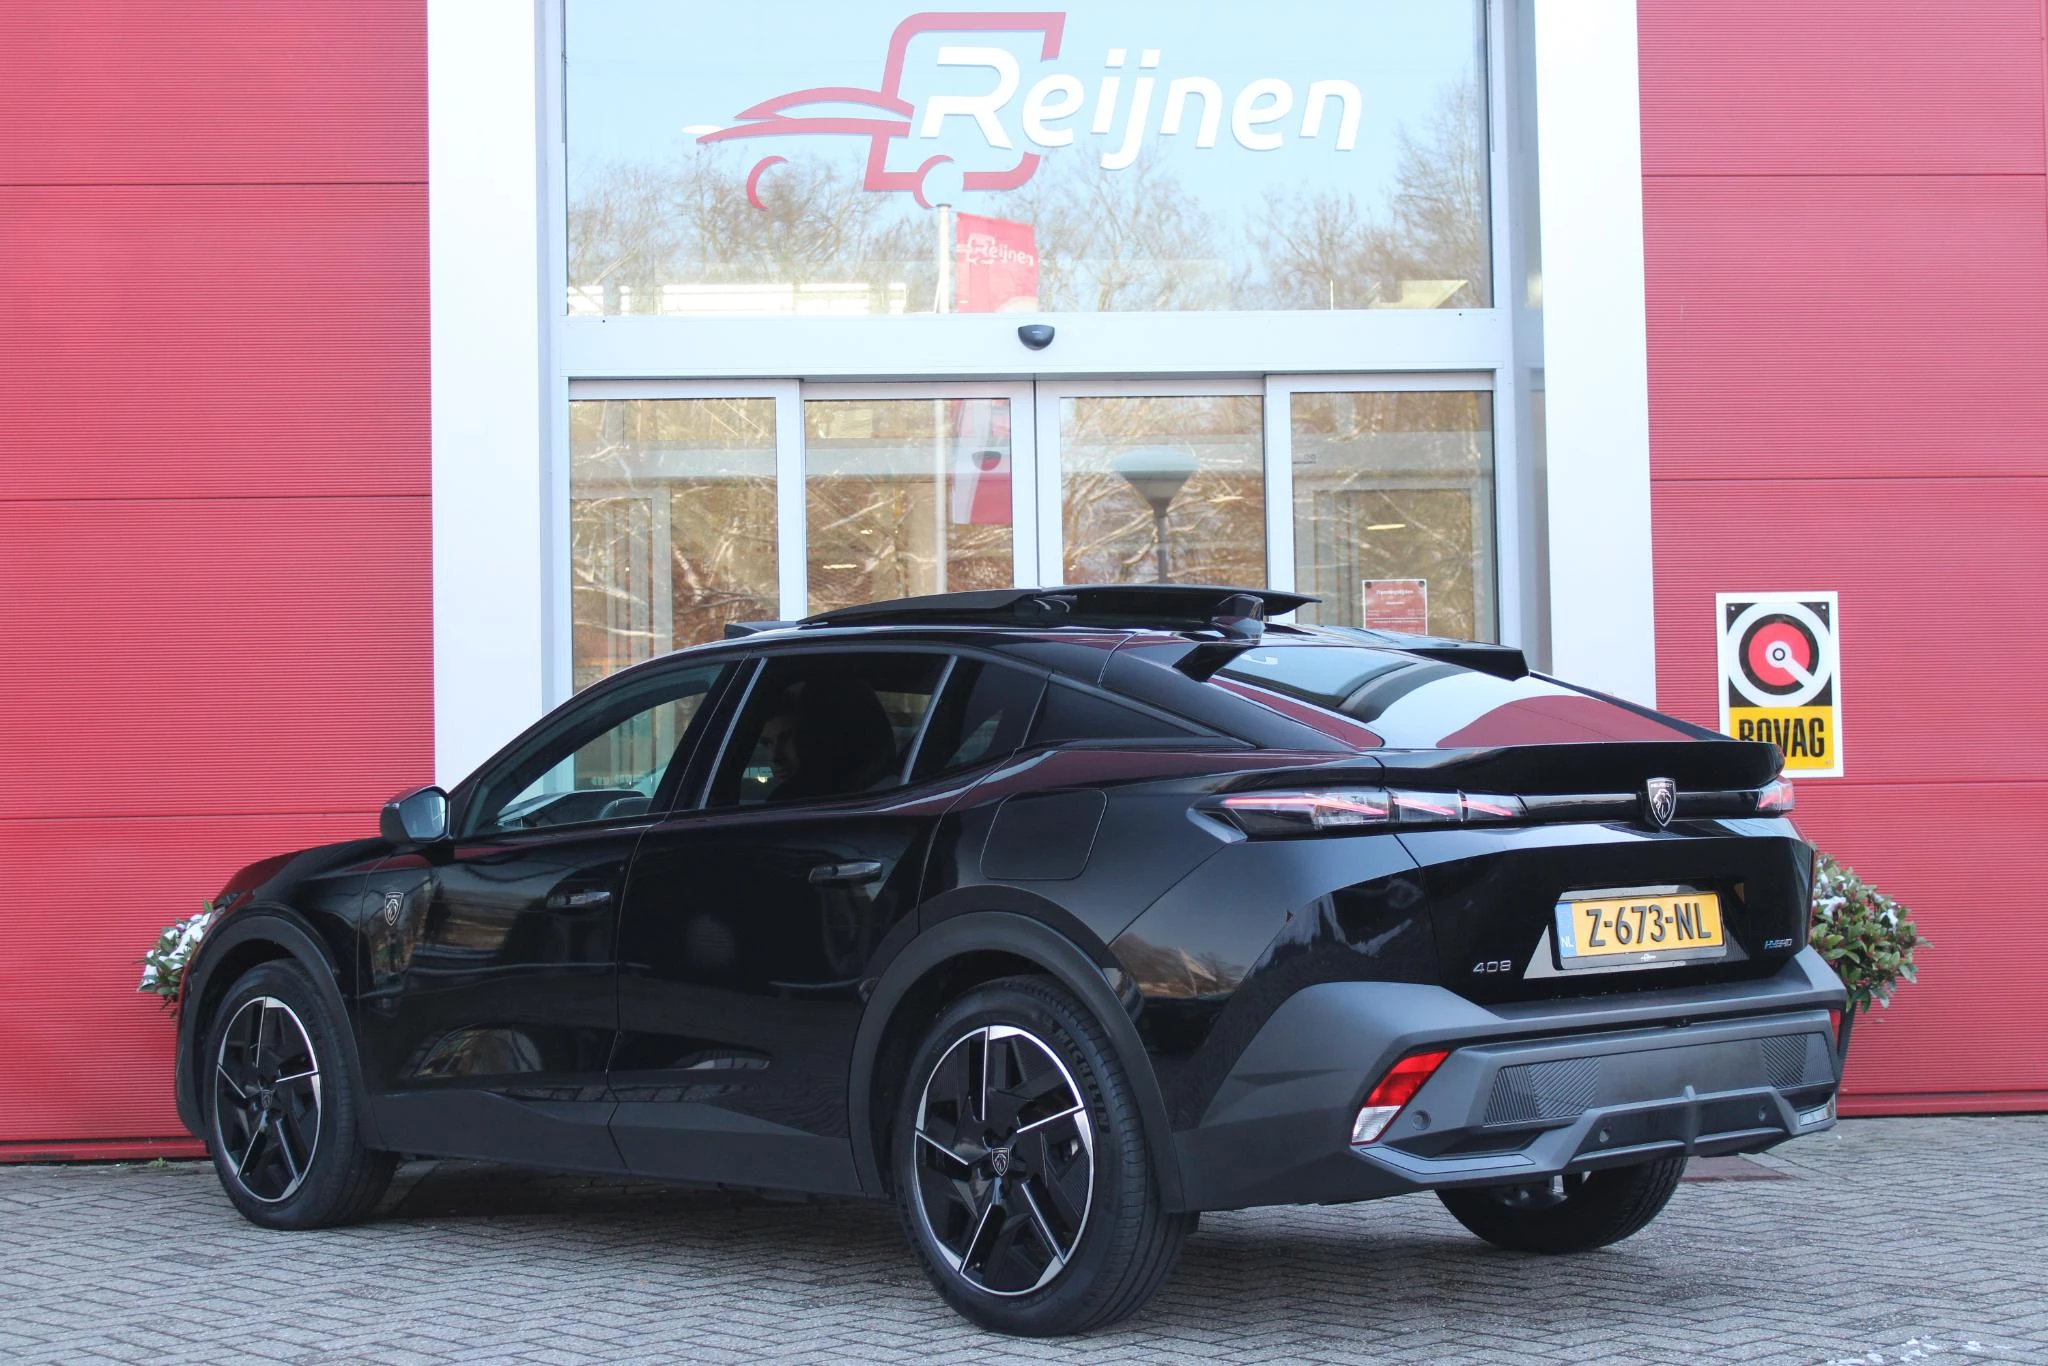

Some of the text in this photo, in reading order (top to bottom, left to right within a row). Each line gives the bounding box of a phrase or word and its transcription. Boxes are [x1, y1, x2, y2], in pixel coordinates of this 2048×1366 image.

[919, 46, 1362, 171] Reijnen
[974, 238, 1034, 267] Reijnen
[1586, 902, 1712, 948] Z-673-NL
[1560, 937, 1574, 948] NL
[1472, 959, 1512, 974] 408
